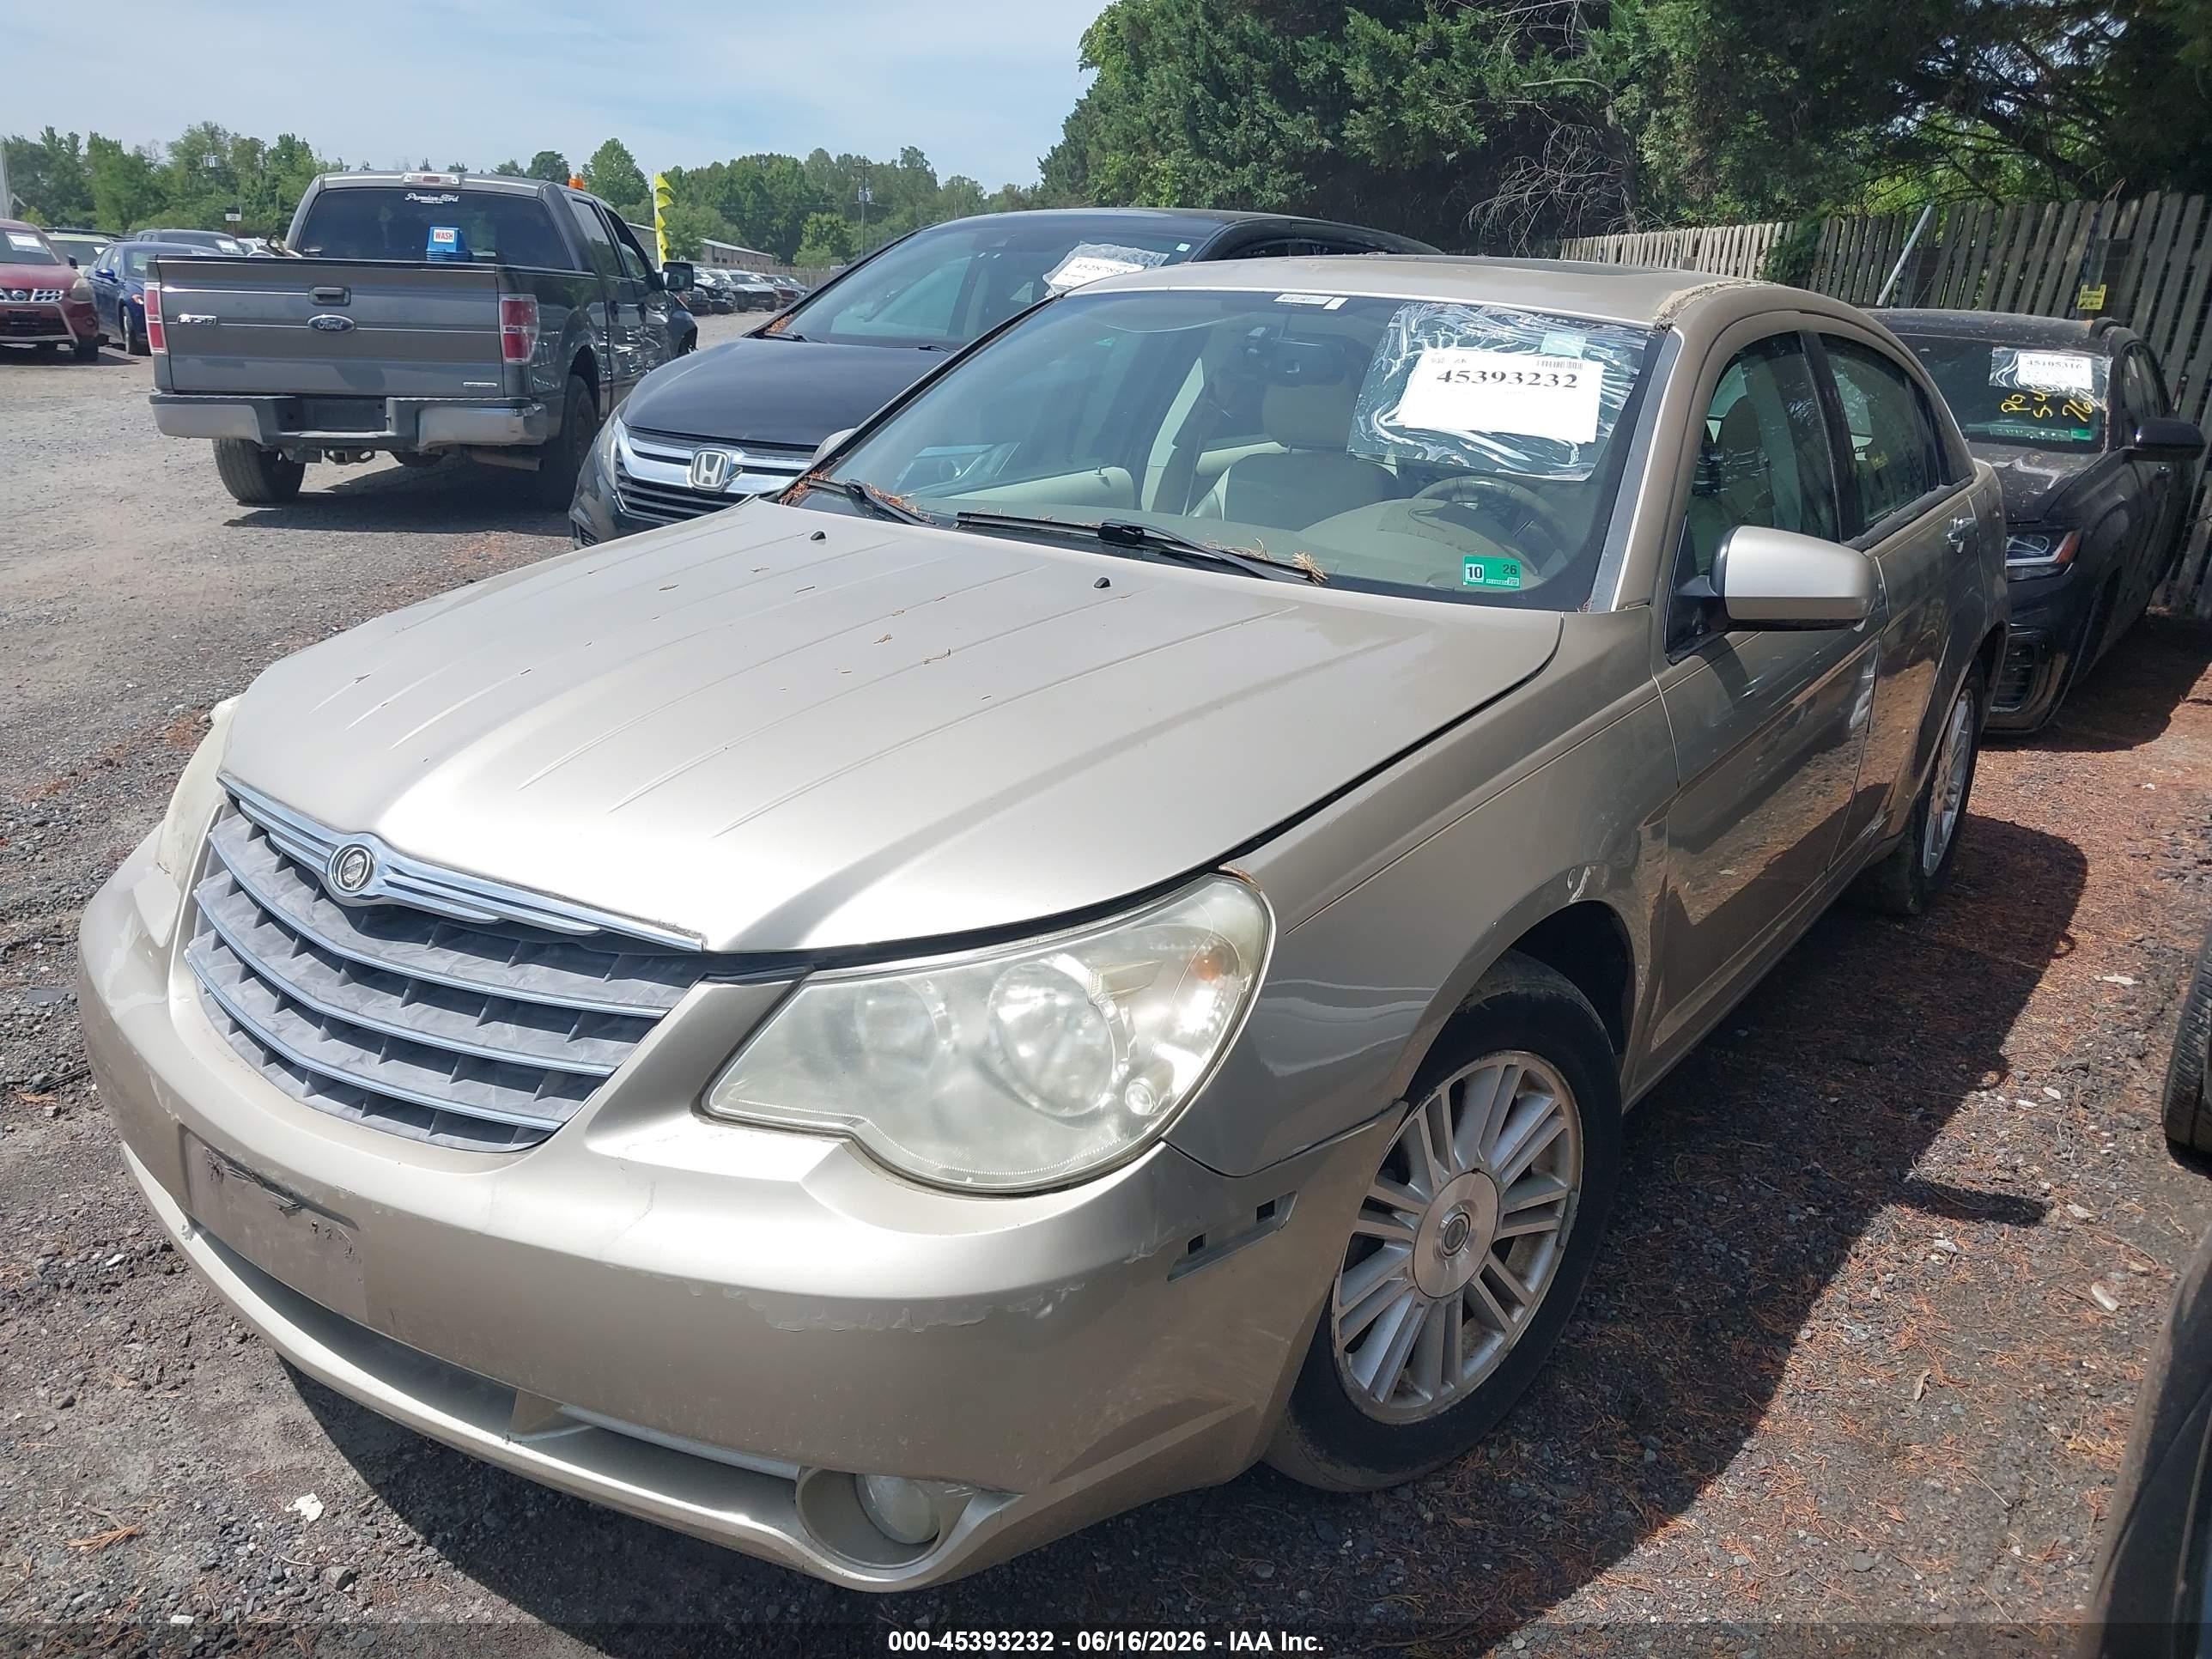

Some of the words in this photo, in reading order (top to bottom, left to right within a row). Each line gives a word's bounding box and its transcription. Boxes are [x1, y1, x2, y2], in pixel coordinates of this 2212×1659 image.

[435, 231, 453, 240] WASH
[317, 319, 343, 331] Ford
[1436, 369, 1578, 389] 45393232
[1468, 566, 1483, 579] 10
[1503, 563, 1517, 574] 26
